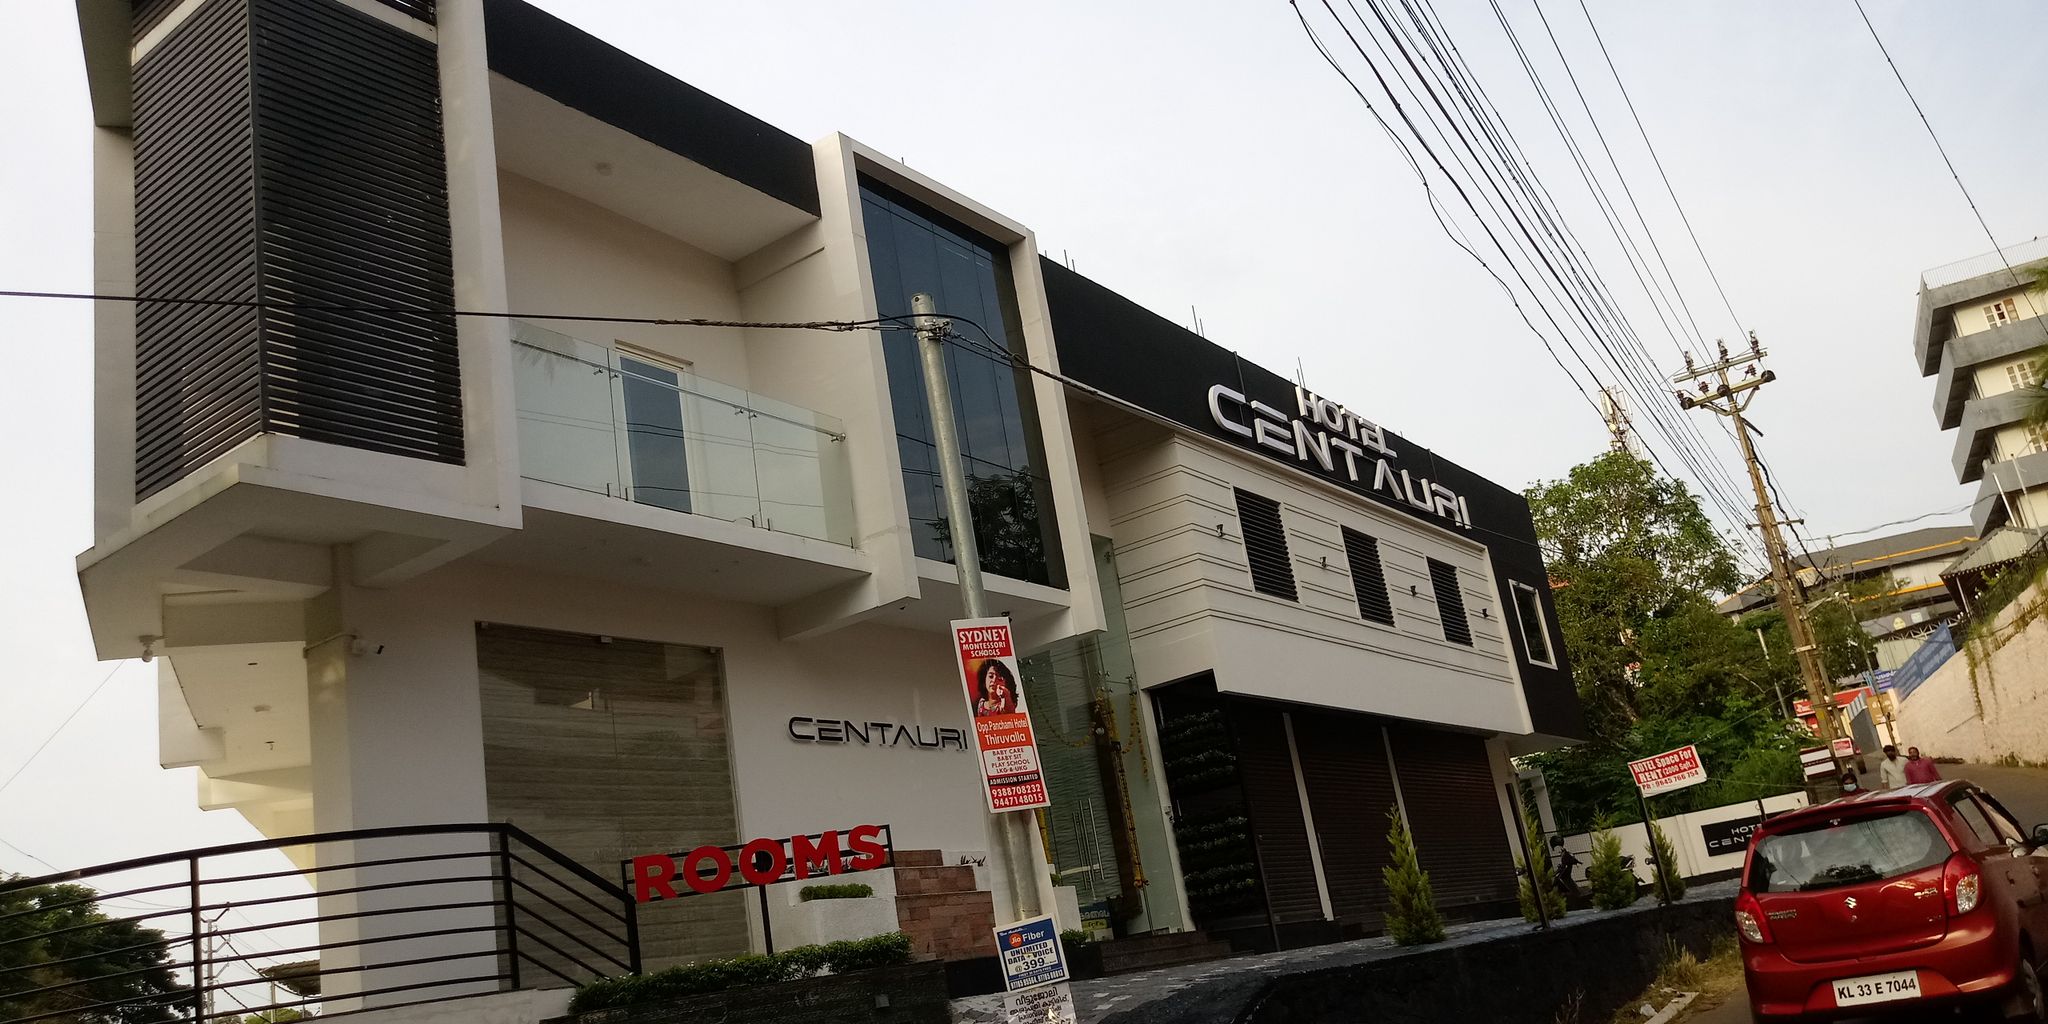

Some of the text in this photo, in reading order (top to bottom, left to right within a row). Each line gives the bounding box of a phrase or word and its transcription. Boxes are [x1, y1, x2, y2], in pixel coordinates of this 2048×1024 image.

[1295, 385, 1397, 459] HOTEL
[1208, 384, 1472, 530] CENTAURI
[959, 629, 1006, 643] SYDNEY
[962, 641, 1006, 651] MONTESSORI
[970, 649, 1001, 657] SCHOOLS
[1014, 718, 1028, 729] Hotel
[788, 716, 968, 750] CENTAURI
[985, 731, 1026, 746] Thiruvalla
[1679, 749, 1693, 761] For
[1006, 759, 1030, 767] SCHOOL
[990, 773, 1038, 785] ADMISSION STARTED
[1638, 768, 1663, 782] RENT
[992, 784, 1041, 797] 9388708232
[994, 793, 1043, 807] 9447148015
[633, 824, 887, 904] ROOMS
[1012, 936, 1022, 945] Jio
[1022, 931, 1044, 943] Fiber
[1008, 955, 1026, 965] DATA
[1032, 947, 1054, 958] VOICE
[1010, 942, 1048, 957] UNLIMITED
[1838, 978, 1916, 999] KL 33 E 7044
